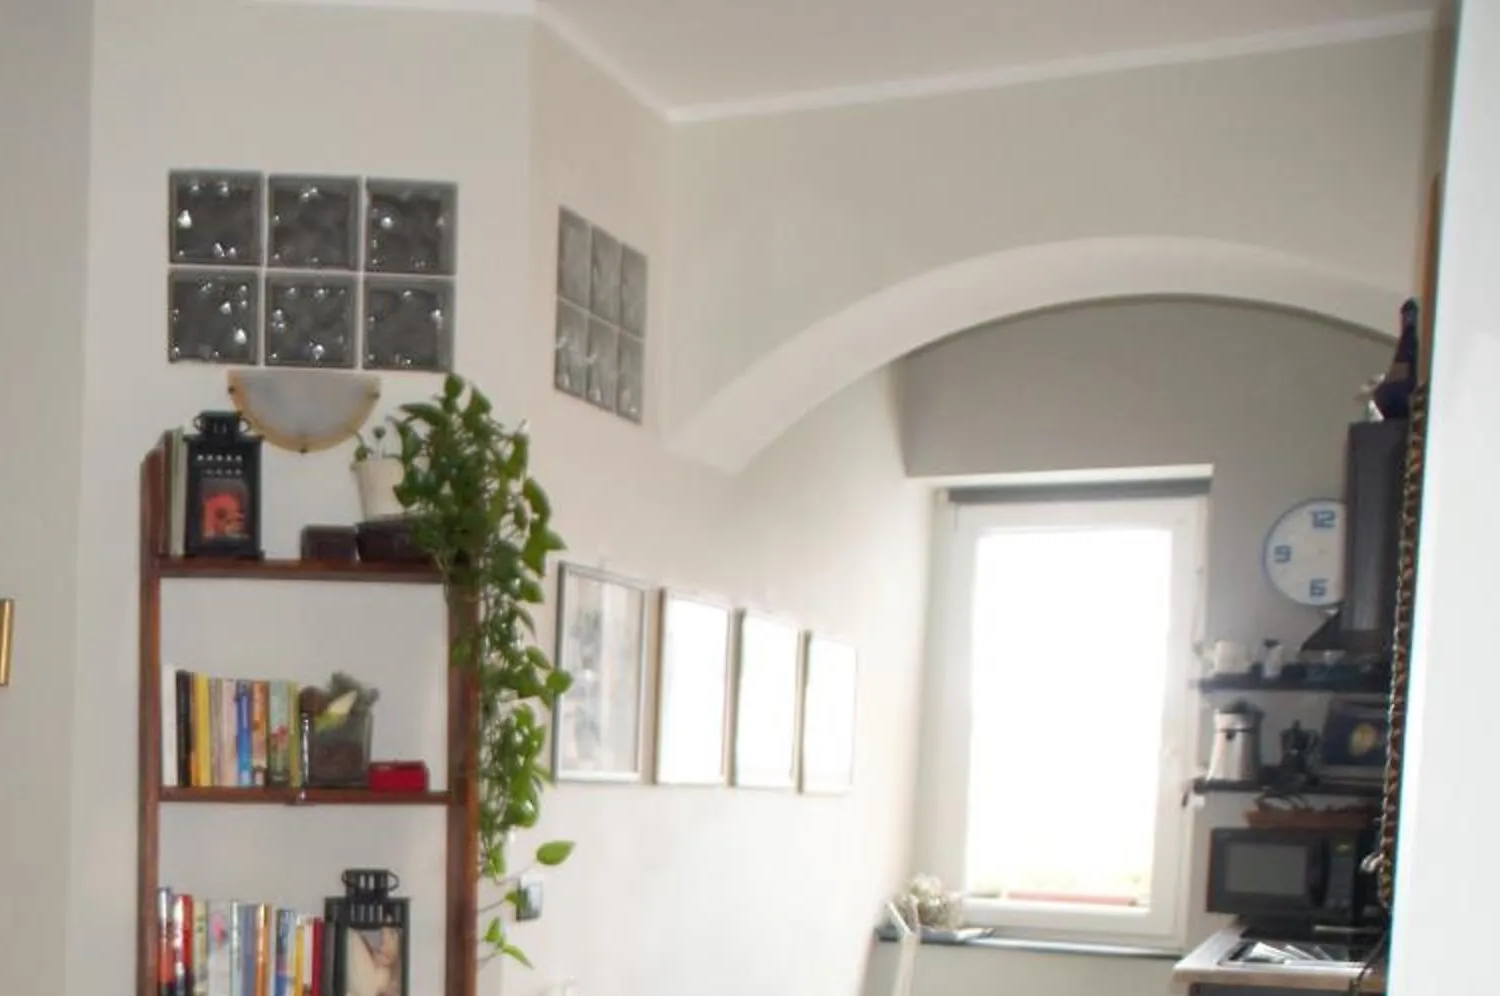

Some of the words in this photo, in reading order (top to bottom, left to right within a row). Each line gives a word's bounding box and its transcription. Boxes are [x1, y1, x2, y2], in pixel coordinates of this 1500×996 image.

[1310, 509, 1336, 529] 12
[1274, 544, 1292, 564] 9
[1309, 578, 1327, 597] 6
